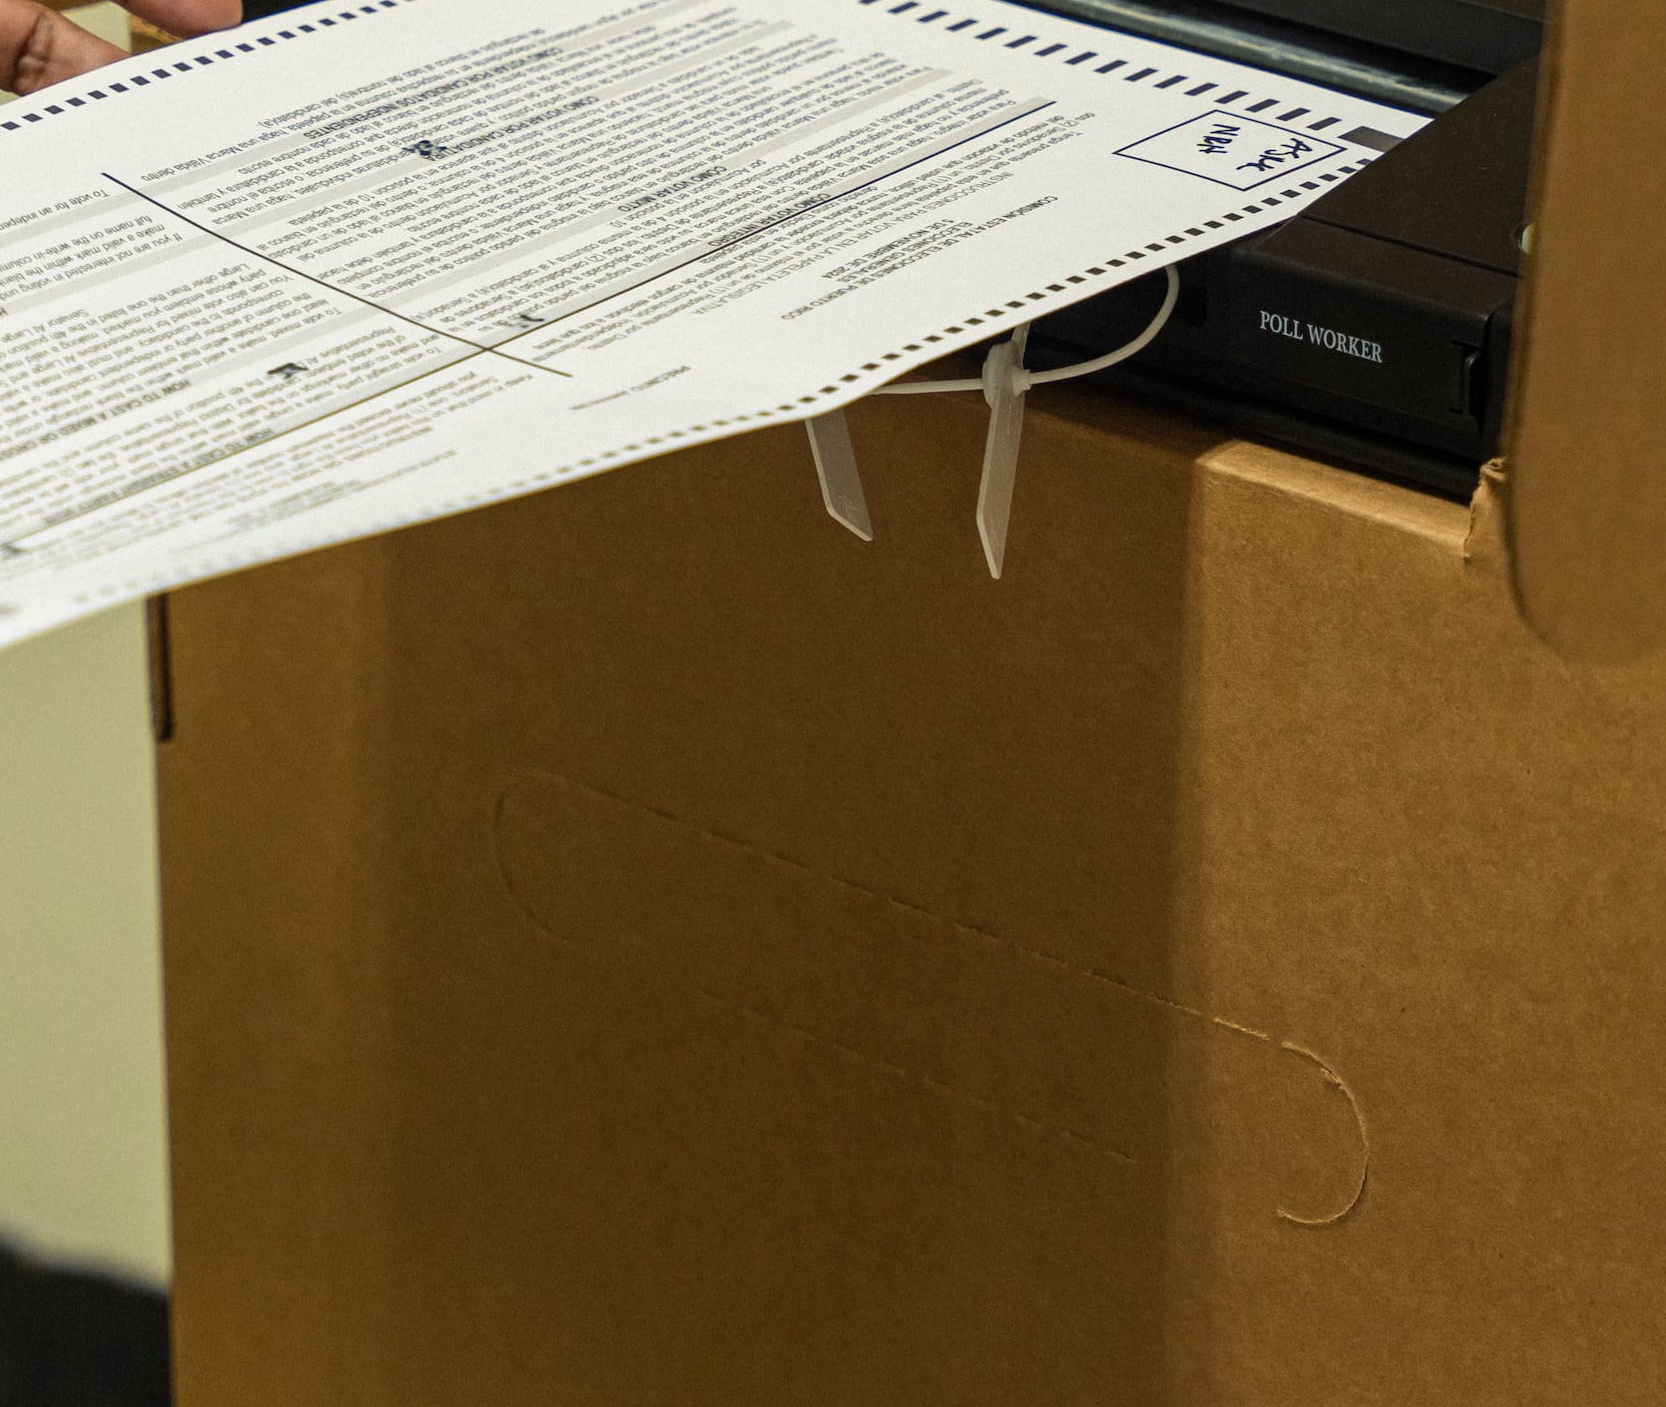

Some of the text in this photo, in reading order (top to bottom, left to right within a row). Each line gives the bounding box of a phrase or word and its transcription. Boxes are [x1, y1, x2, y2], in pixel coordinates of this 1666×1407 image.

[392, 78, 471, 107] CANDIDATOS
[559, 95, 604, 112] CÓMO
[299, 102, 402, 139] INDEPENDIENTES
[521, 107, 569, 125] VOTAR
[252, 127, 291, 142] haga
[170, 156, 212, 172] Válida
[202, 145, 244, 161] Marca
[139, 167, 180, 182] dentro
[615, 165, 731, 212] CÓMO VOTAR MIXTO
[919, 170, 1012, 210] INSTRUCCIONES
[705, 191, 833, 248] CÓMO VOTAR ÍNTEGRO
[890, 207, 928, 223] PARA
[999, 194, 1061, 220] COMISIÓN
[852, 220, 899, 241] VOTAR
[952, 216, 1008, 240] ESTATAL
[833, 220, 973, 283] ELECCIONES GENERALES
[860, 228, 932, 260] NOVIEMBRE
[760, 252, 827, 282] PAPELETA
[868, 244, 945, 279] ELECCIONES
[689, 278, 769, 314] LEGISLATIVA
[806, 283, 860, 307] PUERTO
[778, 304, 815, 321] RICO
[1259, 309, 1383, 363] POLL WORKER
